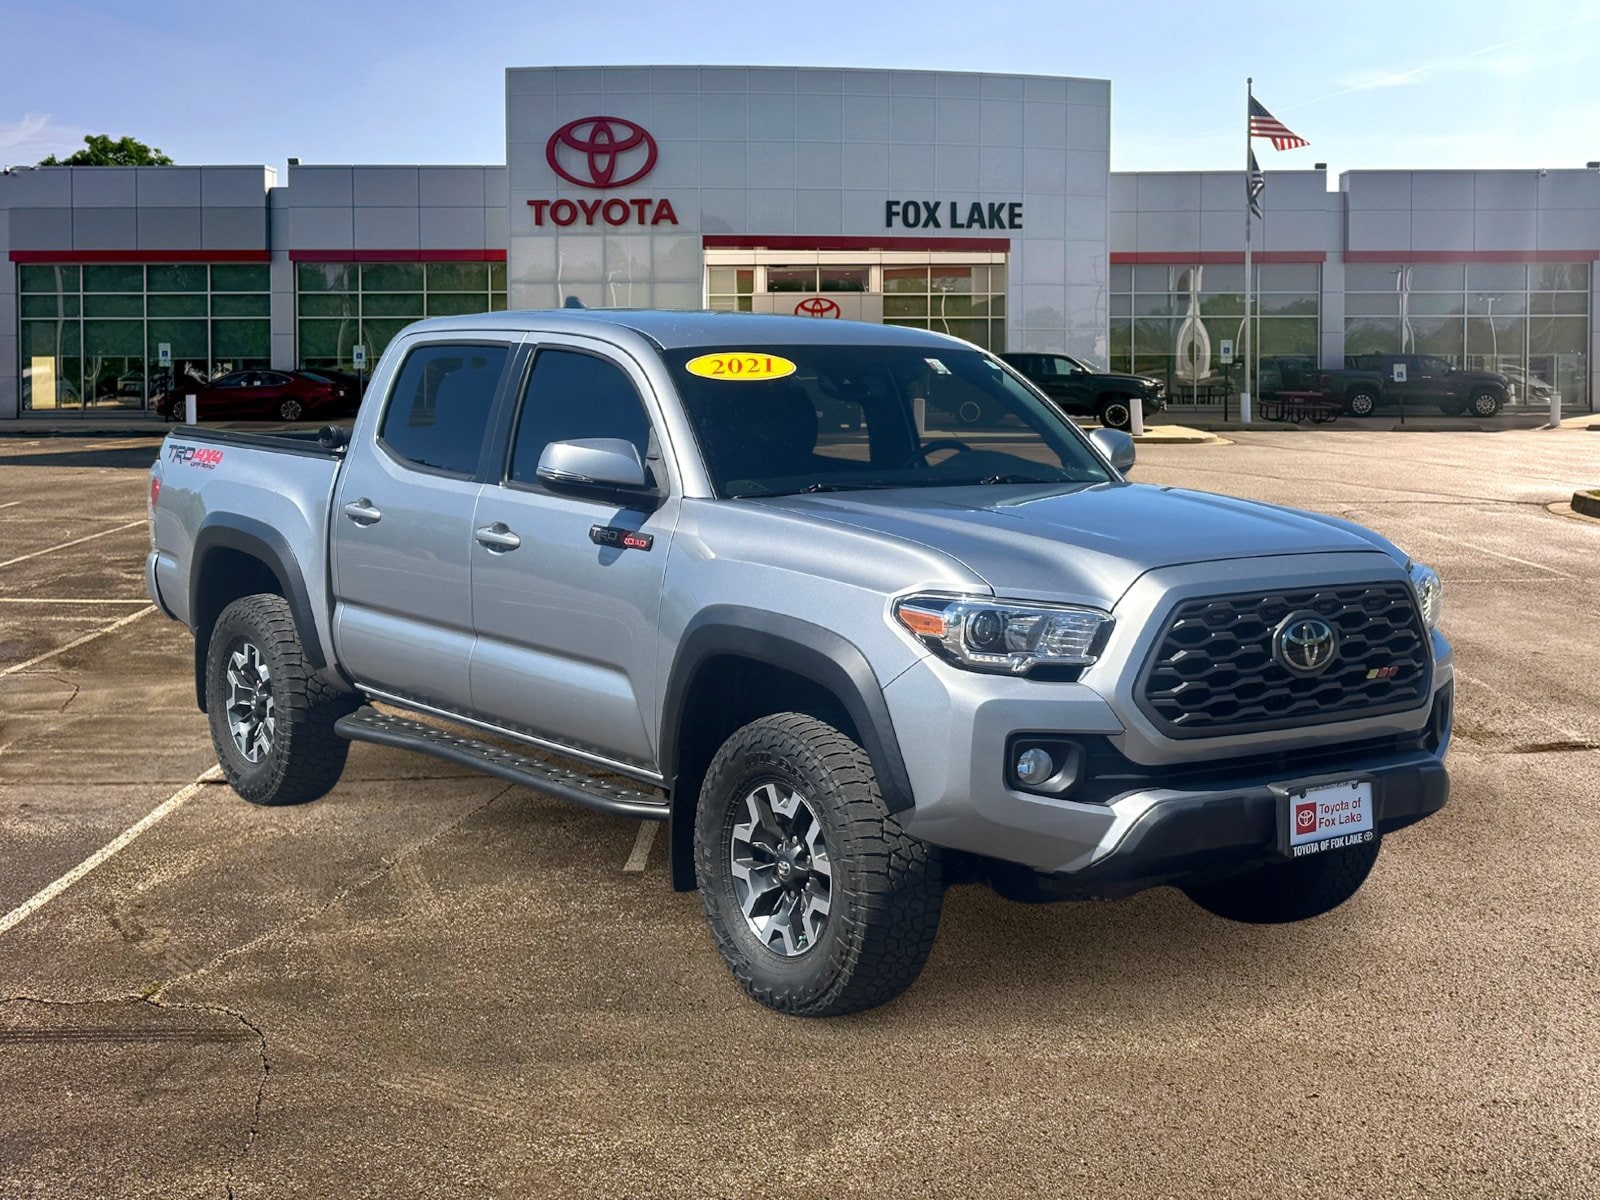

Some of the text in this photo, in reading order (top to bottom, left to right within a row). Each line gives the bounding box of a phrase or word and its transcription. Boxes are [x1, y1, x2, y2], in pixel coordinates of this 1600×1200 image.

[527, 198, 679, 226] TOYOTA
[886, 200, 1023, 229] FOX LAKE
[711, 358, 774, 375] 2021
[1319, 797, 1361, 815] Toyota of
[1319, 812, 1362, 828] Fox Lake
[1293, 832, 1363, 857] TOYOTA OF FOX LAKE
